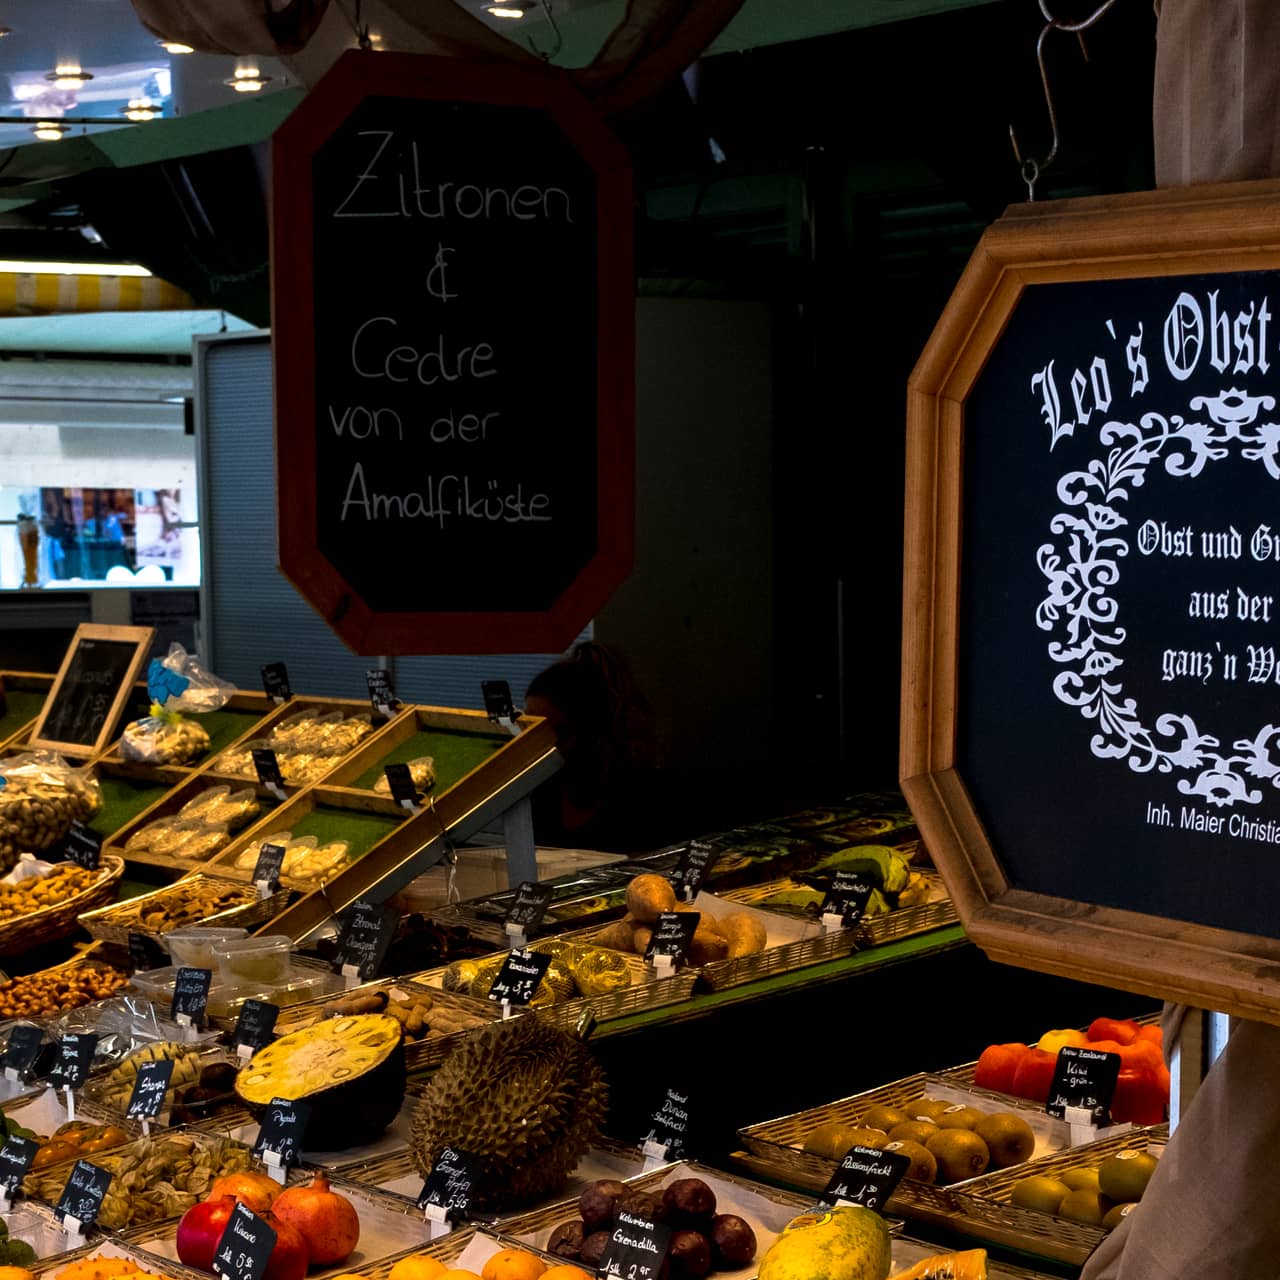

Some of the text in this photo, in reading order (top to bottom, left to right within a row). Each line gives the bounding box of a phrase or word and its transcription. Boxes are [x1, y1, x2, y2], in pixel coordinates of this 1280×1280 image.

[333, 130, 573, 222] Zitronen
[329, 405, 500, 443] von der
[339, 462, 553, 528] Amalfiküste
[1137, 518, 1194, 558] Obst
[1201, 519, 1243, 559] und
[1188, 587, 1273, 622] aus der
[1145, 801, 1175, 827] Inh.
[1180, 805, 1224, 836] Maier
